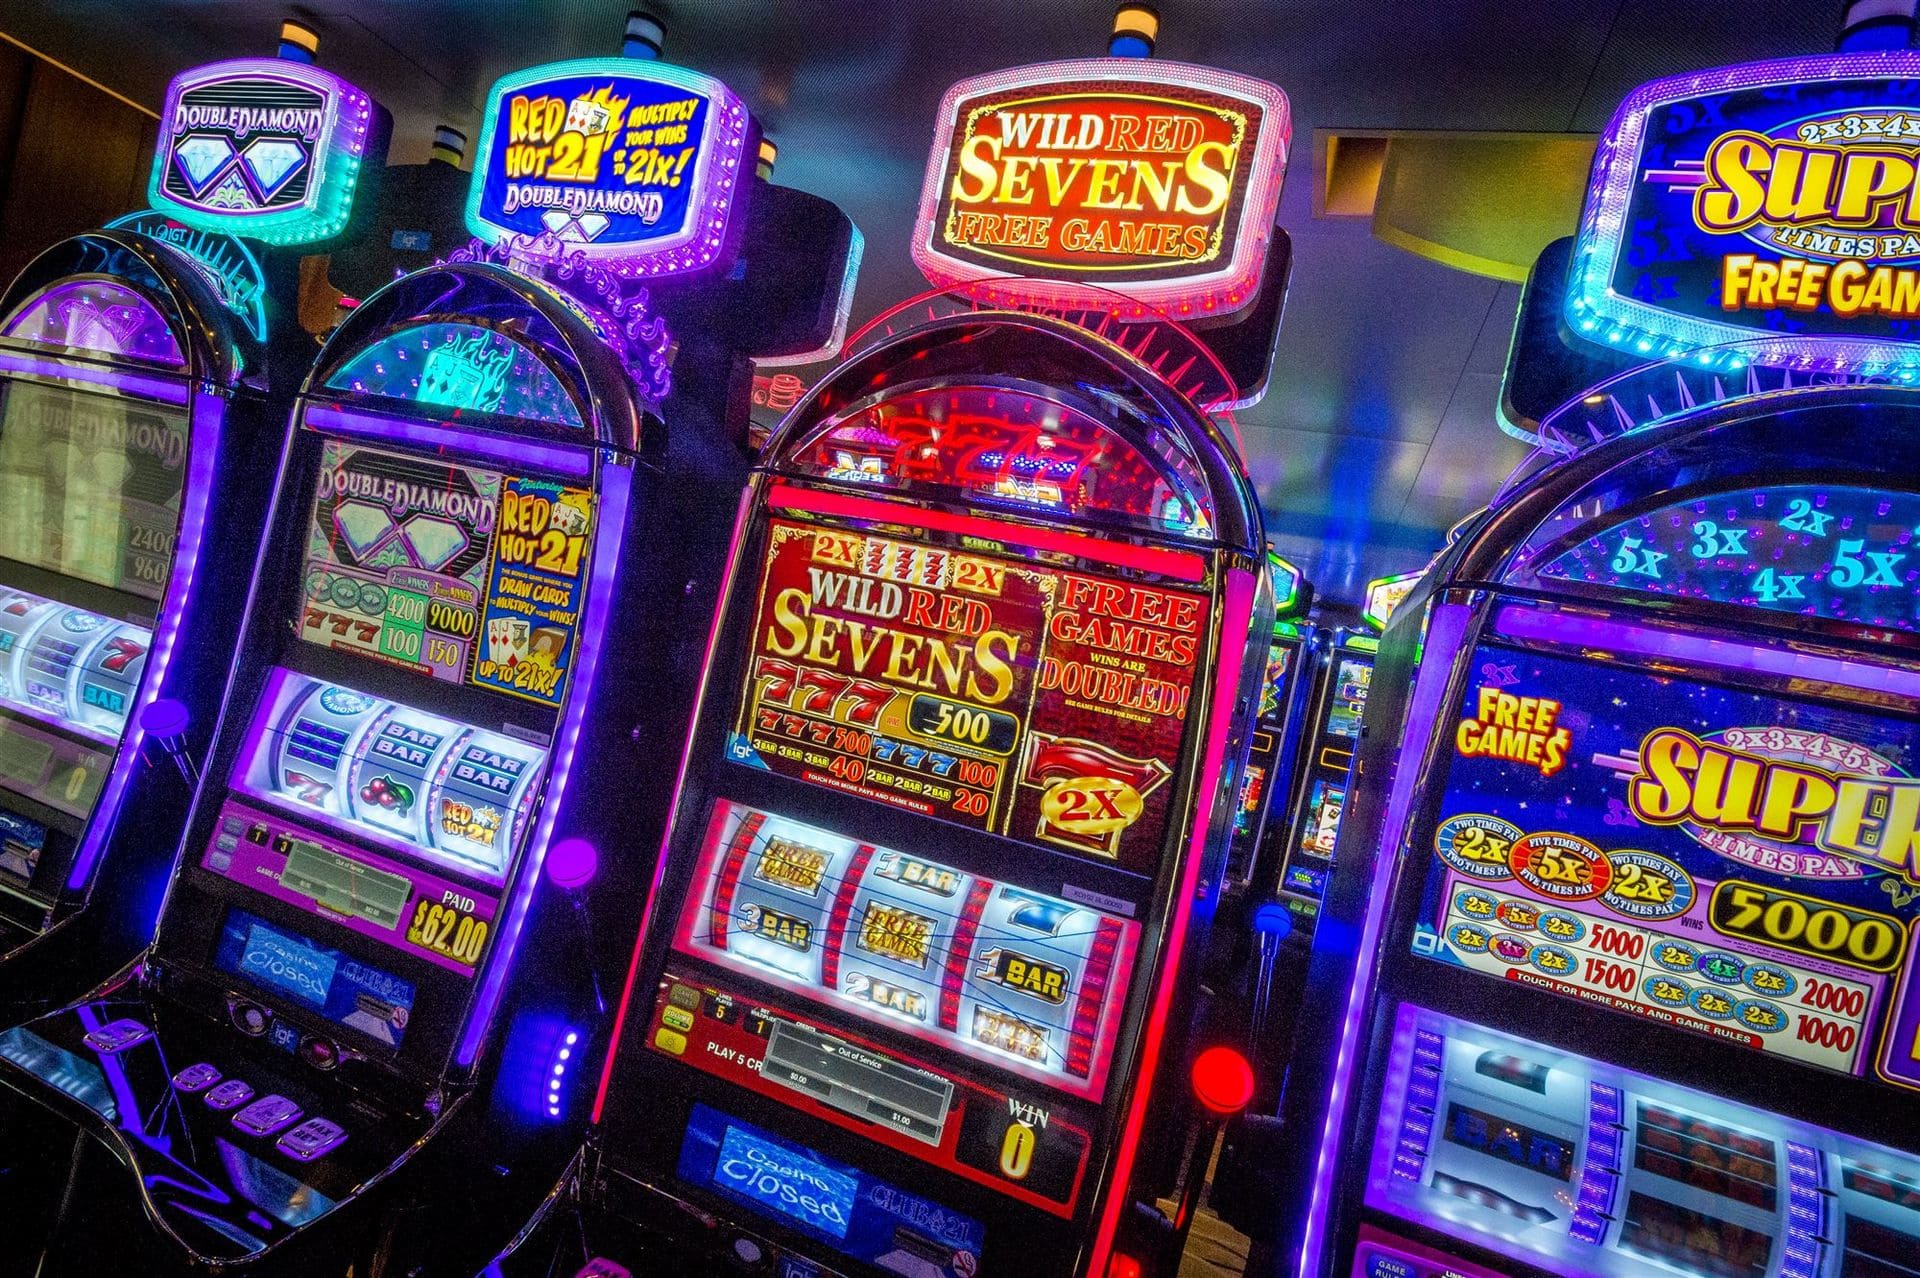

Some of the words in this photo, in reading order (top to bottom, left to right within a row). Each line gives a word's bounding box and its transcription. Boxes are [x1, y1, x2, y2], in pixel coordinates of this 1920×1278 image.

[510, 95, 566, 144] RED
[627, 98, 699, 128] MULTIPLY
[625, 130, 653, 147] YOUR
[654, 125, 688, 146] WINS
[998, 111, 1104, 151] WILD
[1104, 115, 1204, 153] RED
[506, 142, 552, 178] HOT
[546, 130, 608, 182] 21
[613, 150, 626, 162] UP
[613, 162, 626, 175] TO
[951, 134, 1238, 215] SEVENS
[956, 211, 1053, 250] FREE
[1061, 219, 1209, 258] GAMES
[1775, 227, 1876, 257] TIMES
[1723, 254, 1828, 310] FREE
[503, 490, 550, 536] RED
[500, 534, 539, 565] HOT
[535, 530, 586, 577] 21
[815, 534, 857, 564] 2X
[958, 561, 1002, 591] 2X
[499, 577, 532, 597] DRAW
[533, 585, 570, 608] CARDS
[807, 566, 902, 620] WILD
[903, 588, 993, 637] RED
[1058, 575, 1200, 633] FREE
[387, 592, 425, 624] 4200
[430, 603, 474, 635] 9000
[495, 597, 537, 616] MULTIPLY
[549, 610, 576, 626] WINS!
[386, 627, 419, 657] 100
[428, 638, 458, 667] 150
[766, 587, 1020, 705] SEVENS
[1050, 610, 1197, 666] GAMES
[479, 661, 497, 677] UP
[498, 665, 514, 683] TO
[1090, 652, 1120, 667] WINS
[1121, 658, 1146, 673] ARE
[85, 685, 123, 713] BAR
[1039, 656, 1190, 720] DOUBLED!
[936, 703, 990, 743] 500
[1478, 686, 1561, 735] FREE
[385, 723, 437, 747] BAR
[834, 729, 870, 755] 500
[1457, 719, 1571, 776] GAME$
[375, 738, 427, 764] BAR
[468, 748, 522, 773] BAR
[733, 743, 753, 758] igt
[456, 766, 509, 792] BAR
[829, 757, 863, 781] 40
[958, 760, 996, 787] 100
[807, 772, 827, 785] TOUCH
[828, 778, 840, 787] FOR
[840, 781, 858, 792] MORE
[858, 786, 875, 797] PAYS
[875, 790, 889, 801] AND
[889, 794, 908, 805] GAME
[907, 800, 929, 811] RULES
[953, 789, 988, 816] 20
[1057, 789, 1127, 821] 2X
[442, 799, 473, 824] RED
[254, 831, 262, 842] 1
[467, 824, 496, 848] 21
[1454, 819, 1475, 830] TWO
[1475, 819, 1502, 835] TIMES
[1502, 827, 1522, 842] PAY
[280, 841, 288, 853] 3
[772, 842, 825, 870] FREE
[1529, 836, 1551, 848] FIVE
[1552, 837, 1580, 853] TIMES
[1580, 846, 1600, 863] PAY
[1701, 829, 1799, 873] TIMES
[1801, 856, 1863, 877] PAY
[256, 866, 274, 878] GAME
[764, 857, 817, 887] GAMES
[902, 862, 954, 890] BAR
[1447, 850, 1464, 870] TWO
[1464, 865, 1495, 877] TIMES
[1630, 856, 1657, 873] TIMES
[1658, 864, 1681, 882] PAY
[1519, 868, 1540, 887] FIVE
[1540, 883, 1573, 896] TIMES
[1573, 884, 1594, 895] PAY
[441, 890, 475, 913] PAID
[1617, 901, 1653, 915] TIMES
[1653, 903, 1675, 915] PAY
[414, 900, 488, 963] $62.00
[763, 914, 808, 946] BAR
[870, 911, 926, 940] FREE
[1680, 916, 1704, 931] WINS
[1725, 887, 1894, 961] 5000
[265, 941, 319, 970] Casino
[866, 928, 921, 960] GAMES
[1588, 923, 1644, 960] 5000
[247, 951, 327, 997] Closed
[1006, 959, 1063, 997] BAR
[1583, 957, 1636, 993] 1500
[872, 985, 919, 1013] BAR
[1517, 973, 1552, 988] TOUCH
[1556, 984, 1578, 995] FOR
[1580, 991, 1611, 1005] MORE
[1615, 1001, 1644, 1013] PAYS
[1647, 1009, 1672, 1021] AND
[1676, 1017, 1711, 1032] GAME
[1713, 1028, 1751, 1043] RULES
[1802, 977, 1865, 1017] 2000
[715, 1006, 726, 1019] 5
[757, 1020, 765, 1034] 1
[276, 1029, 294, 1044] igt
[1797, 1014, 1855, 1052] 1000
[706, 1042, 737, 1061] PLAY
[737, 1055, 745, 1065] 5
[838, 1047, 851, 1057] Out
[859, 1055, 882, 1069] Service
[790, 1072, 807, 1084] $0.00
[893, 1113, 910, 1125] $1.00
[1007, 1098, 1049, 1129] WIN
[292, 1130, 319, 1144] BET
[306, 1121, 334, 1137] MAX
[1001, 1122, 1035, 1181] 0
[746, 1148, 831, 1192] Casino
[722, 1159, 847, 1225] Closed
[869, 1185, 929, 1226] CLUB
[944, 1221, 969, 1242] 21
[1378, 1260, 1406, 1277] GAME
